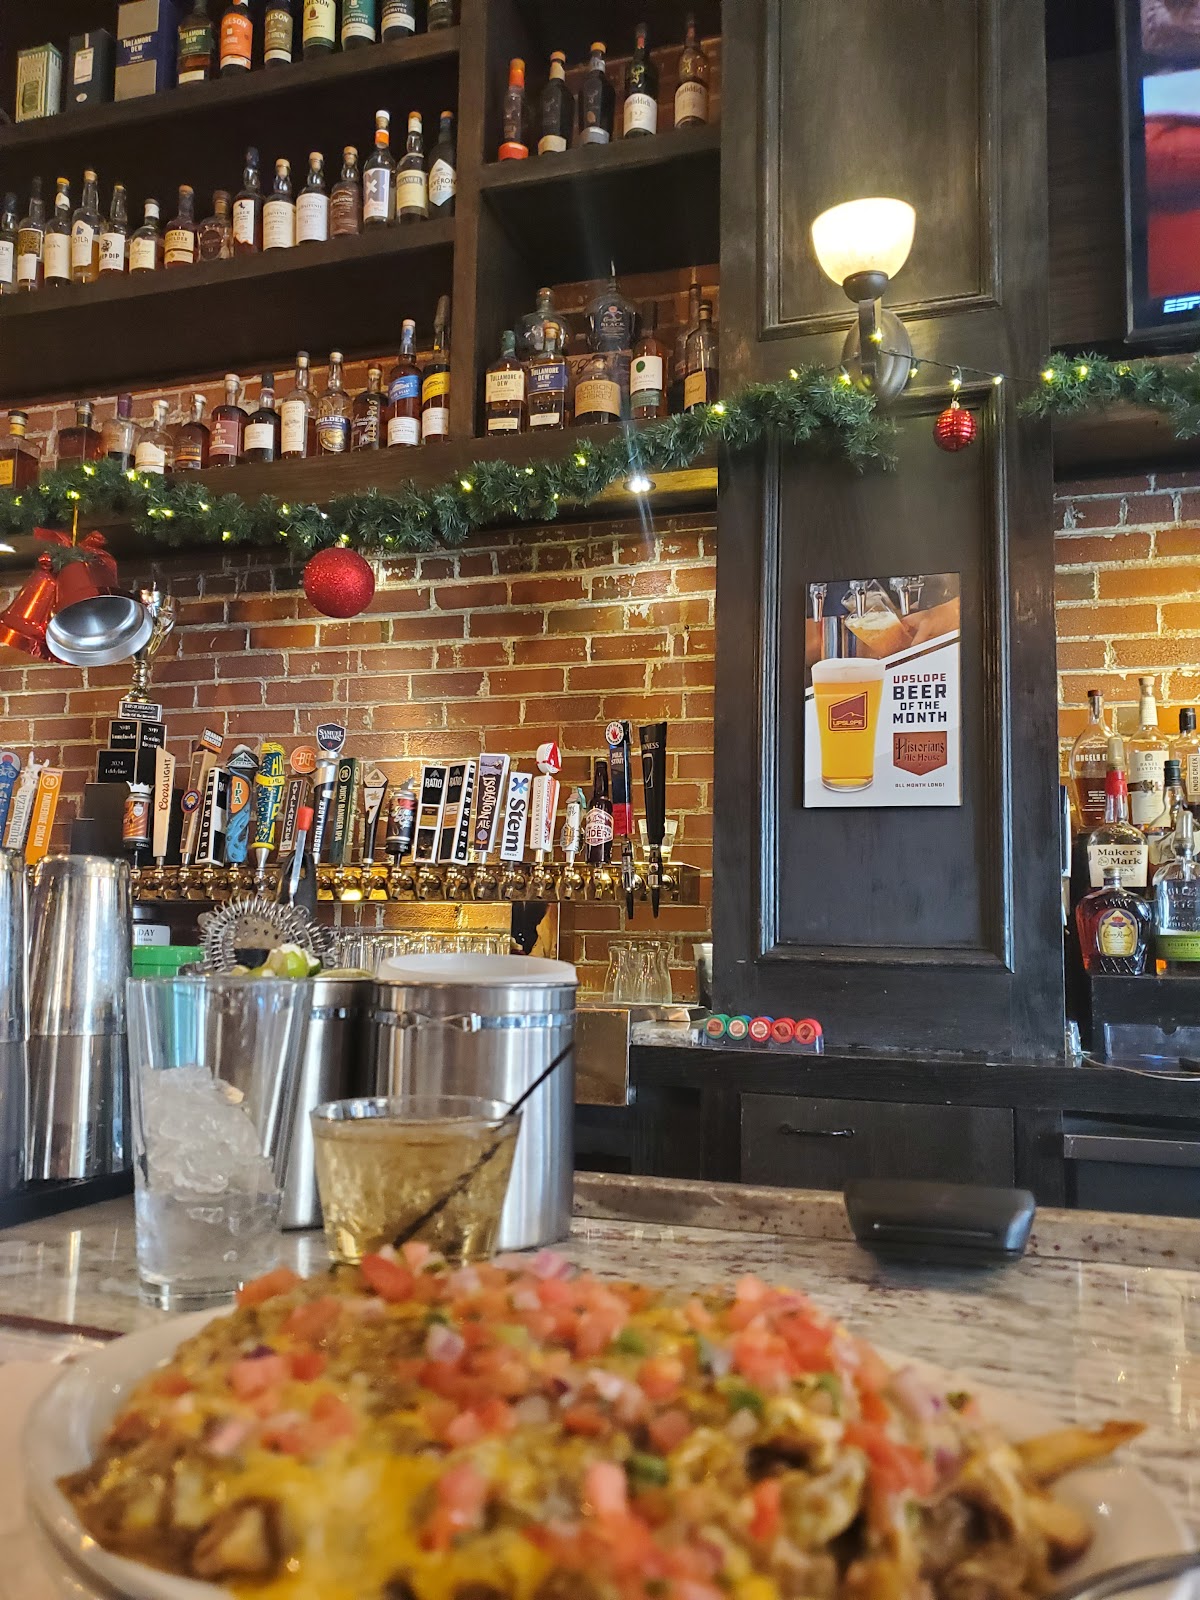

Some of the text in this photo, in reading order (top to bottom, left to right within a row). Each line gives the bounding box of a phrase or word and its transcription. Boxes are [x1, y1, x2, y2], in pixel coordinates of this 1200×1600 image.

[123, 35, 153, 48] TULLAMORE
[130, 44, 143, 53] DEW
[109, 252, 120, 260] DIP
[1163, 296, 1200, 313] ESP
[530, 366, 560, 377] TULLAMORE
[490, 374, 517, 382] TULLAMORE
[537, 374, 550, 382] DEW
[893, 673, 947, 684] UPSLOPE
[893, 684, 947, 700] BEER
[900, 701, 940, 711] OF THE
[893, 711, 947, 724] MONTH
[318, 728, 343, 738] SAMUEL
[320, 733, 341, 742] ADAMS
[611, 758, 624, 766] STOUT
[917, 752, 941, 761] House
[158, 758, 172, 812] Coors LIGHT
[425, 777, 443, 789] RATIO
[449, 776, 462, 788] RATIO
[234, 782, 242, 804] IPA
[478, 776, 497, 820] ISOLATION
[285, 781, 299, 840] AVALANCHE
[312, 801, 327, 853] BOSTON LAGER
[476, 819, 491, 830] ALE
[504, 797, 527, 853] Stem
[33, 825, 47, 847] CREAM
[335, 829, 343, 842] IPA
[1098, 848, 1142, 856] Maker's
[1110, 857, 1142, 865] Mark
